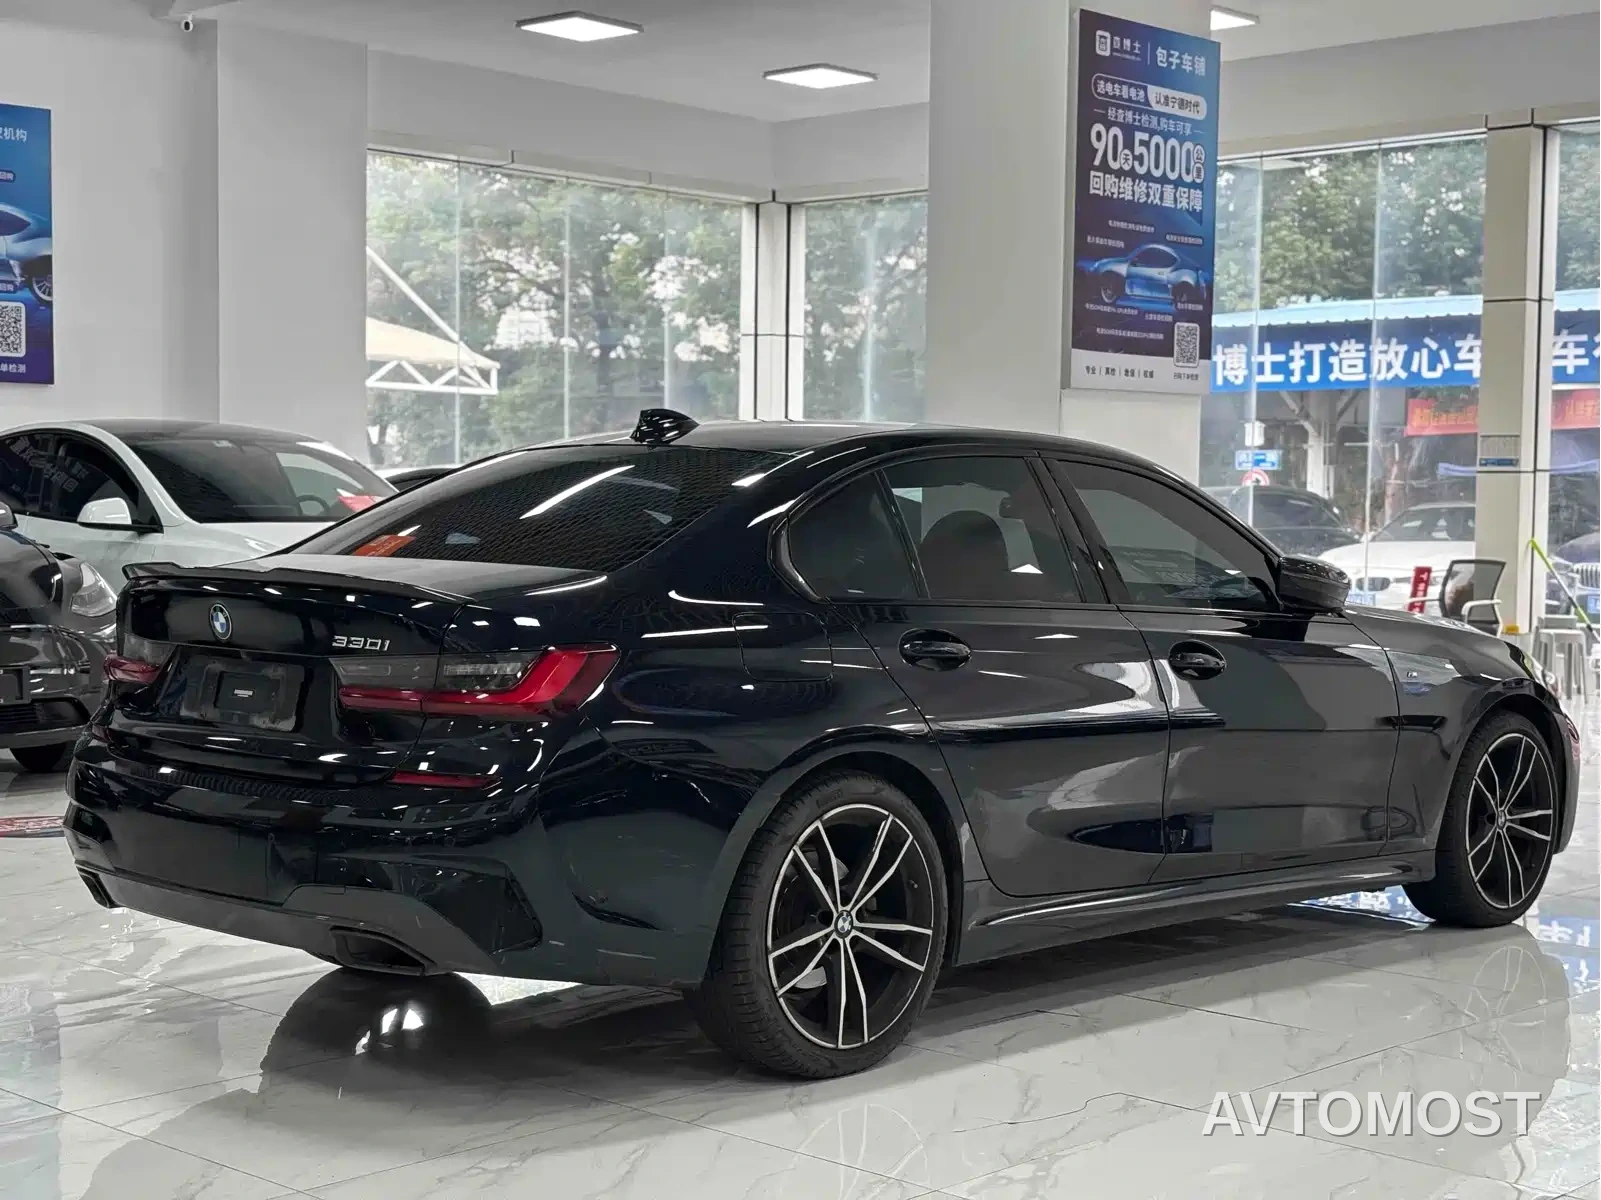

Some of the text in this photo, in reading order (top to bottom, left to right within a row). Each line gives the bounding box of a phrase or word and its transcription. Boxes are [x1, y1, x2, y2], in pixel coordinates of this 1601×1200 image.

[1089, 170, 1203, 212] 回购维修双重保障
